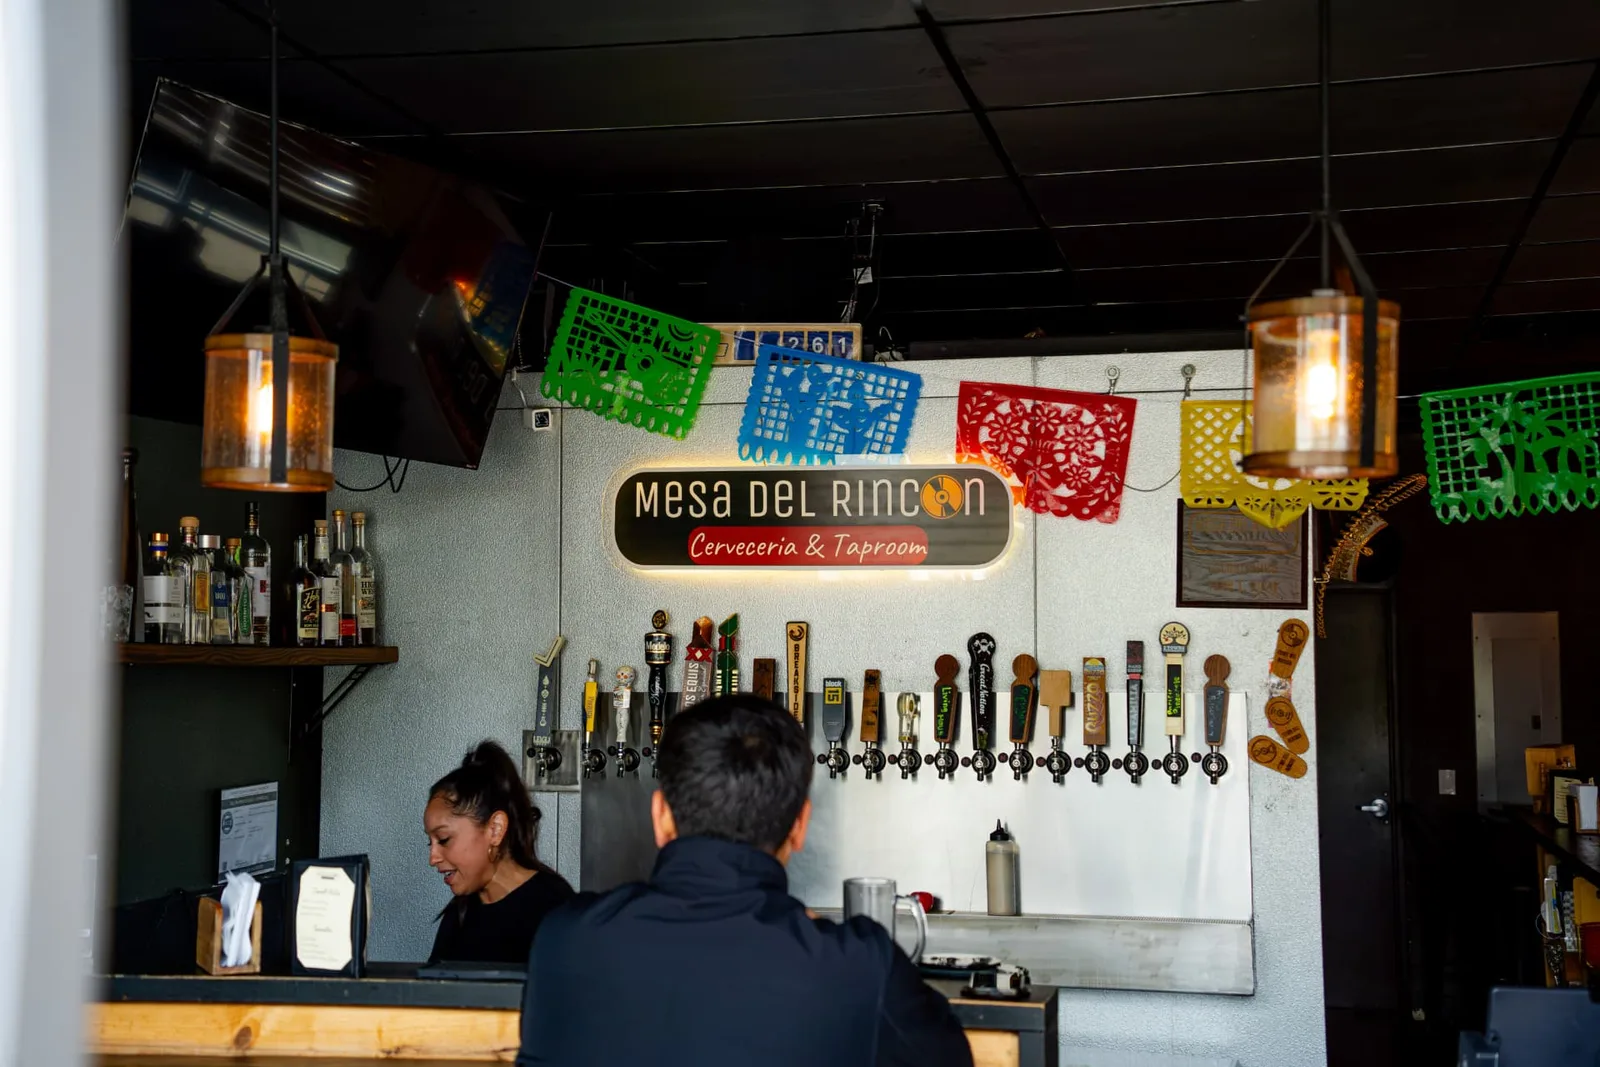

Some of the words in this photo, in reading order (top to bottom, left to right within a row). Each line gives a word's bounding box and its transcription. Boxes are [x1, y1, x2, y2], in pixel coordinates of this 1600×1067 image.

[690, 532, 798, 559] Cerveceria
[805, 533, 825, 559] &
[834, 533, 928, 563] Taproom
[646, 641, 670, 651] Modelo
[686, 662, 699, 692] EQUIS
[980, 663, 991, 689] Great
[941, 686, 952, 713] Living
[979, 687, 989, 715] Notion
